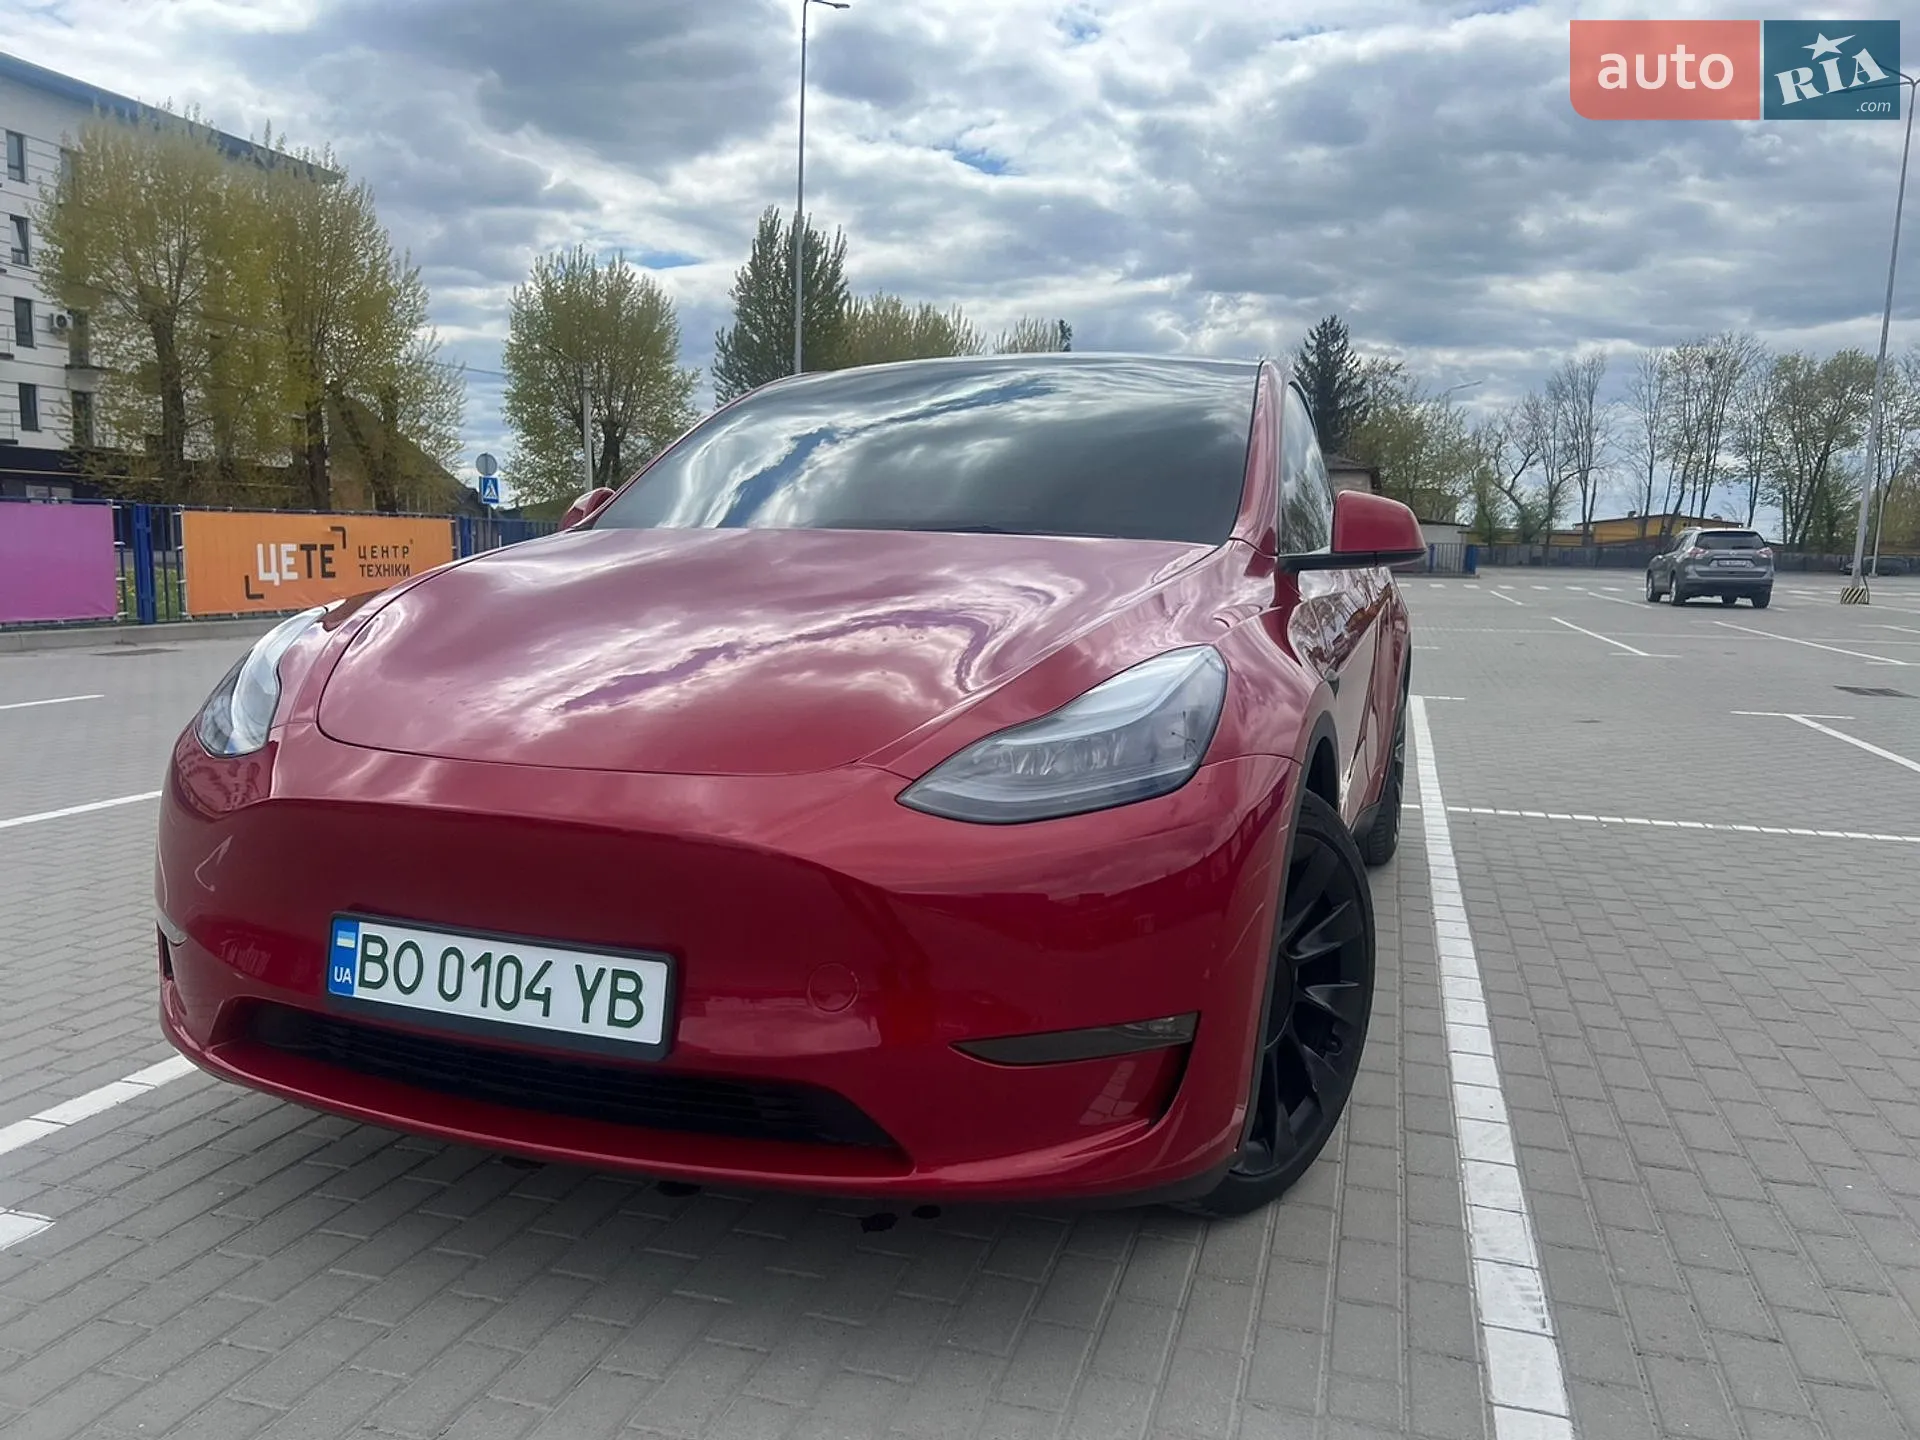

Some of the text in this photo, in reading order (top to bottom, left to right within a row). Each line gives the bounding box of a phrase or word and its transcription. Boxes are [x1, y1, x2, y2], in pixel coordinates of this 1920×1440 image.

[358, 545, 409, 560] ЦЕНТР
[256, 543, 337, 587] ЦЕТЕ
[359, 563, 411, 577] ТЕХНІКИ
[334, 965, 352, 985] UA
[358, 933, 644, 1029] BO 0104 YB
